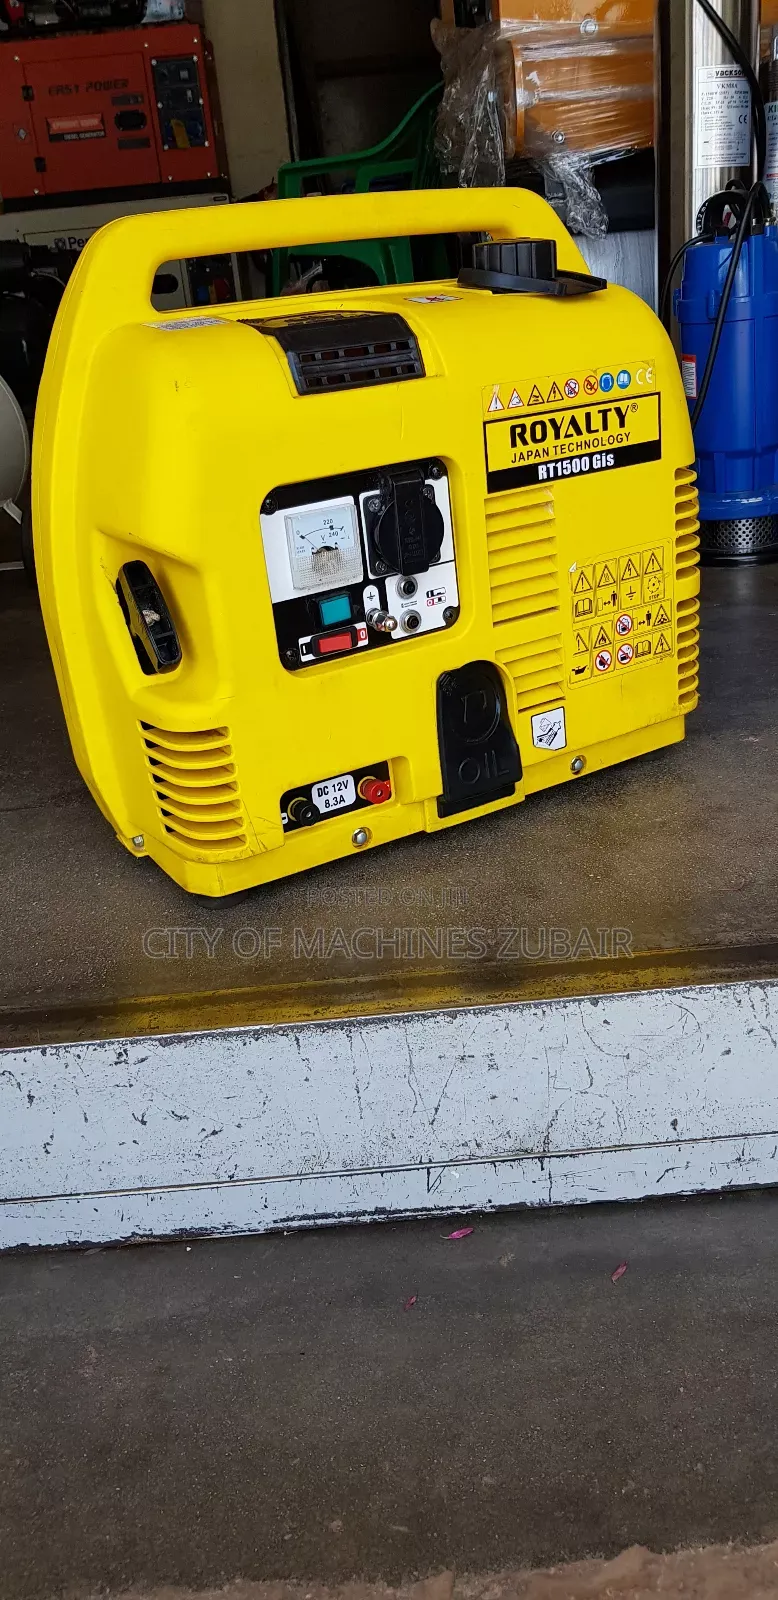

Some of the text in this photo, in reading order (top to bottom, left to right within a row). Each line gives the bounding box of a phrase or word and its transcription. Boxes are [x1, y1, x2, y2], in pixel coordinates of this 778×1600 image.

[86, 78, 129, 92] POWER
[738, 114, 748, 124] CE
[67, 236, 90, 248] Pe
[635, 367, 653, 385] CE
[511, 431, 631, 464] JAPAN TECHNOLOGY
[537, 452, 615, 481] RT1500 Gis
[323, 518, 334, 526] 220
[458, 749, 509, 784] OIL
[316, 779, 349, 799] DC 12V
[324, 795, 346, 810] 8.3A
